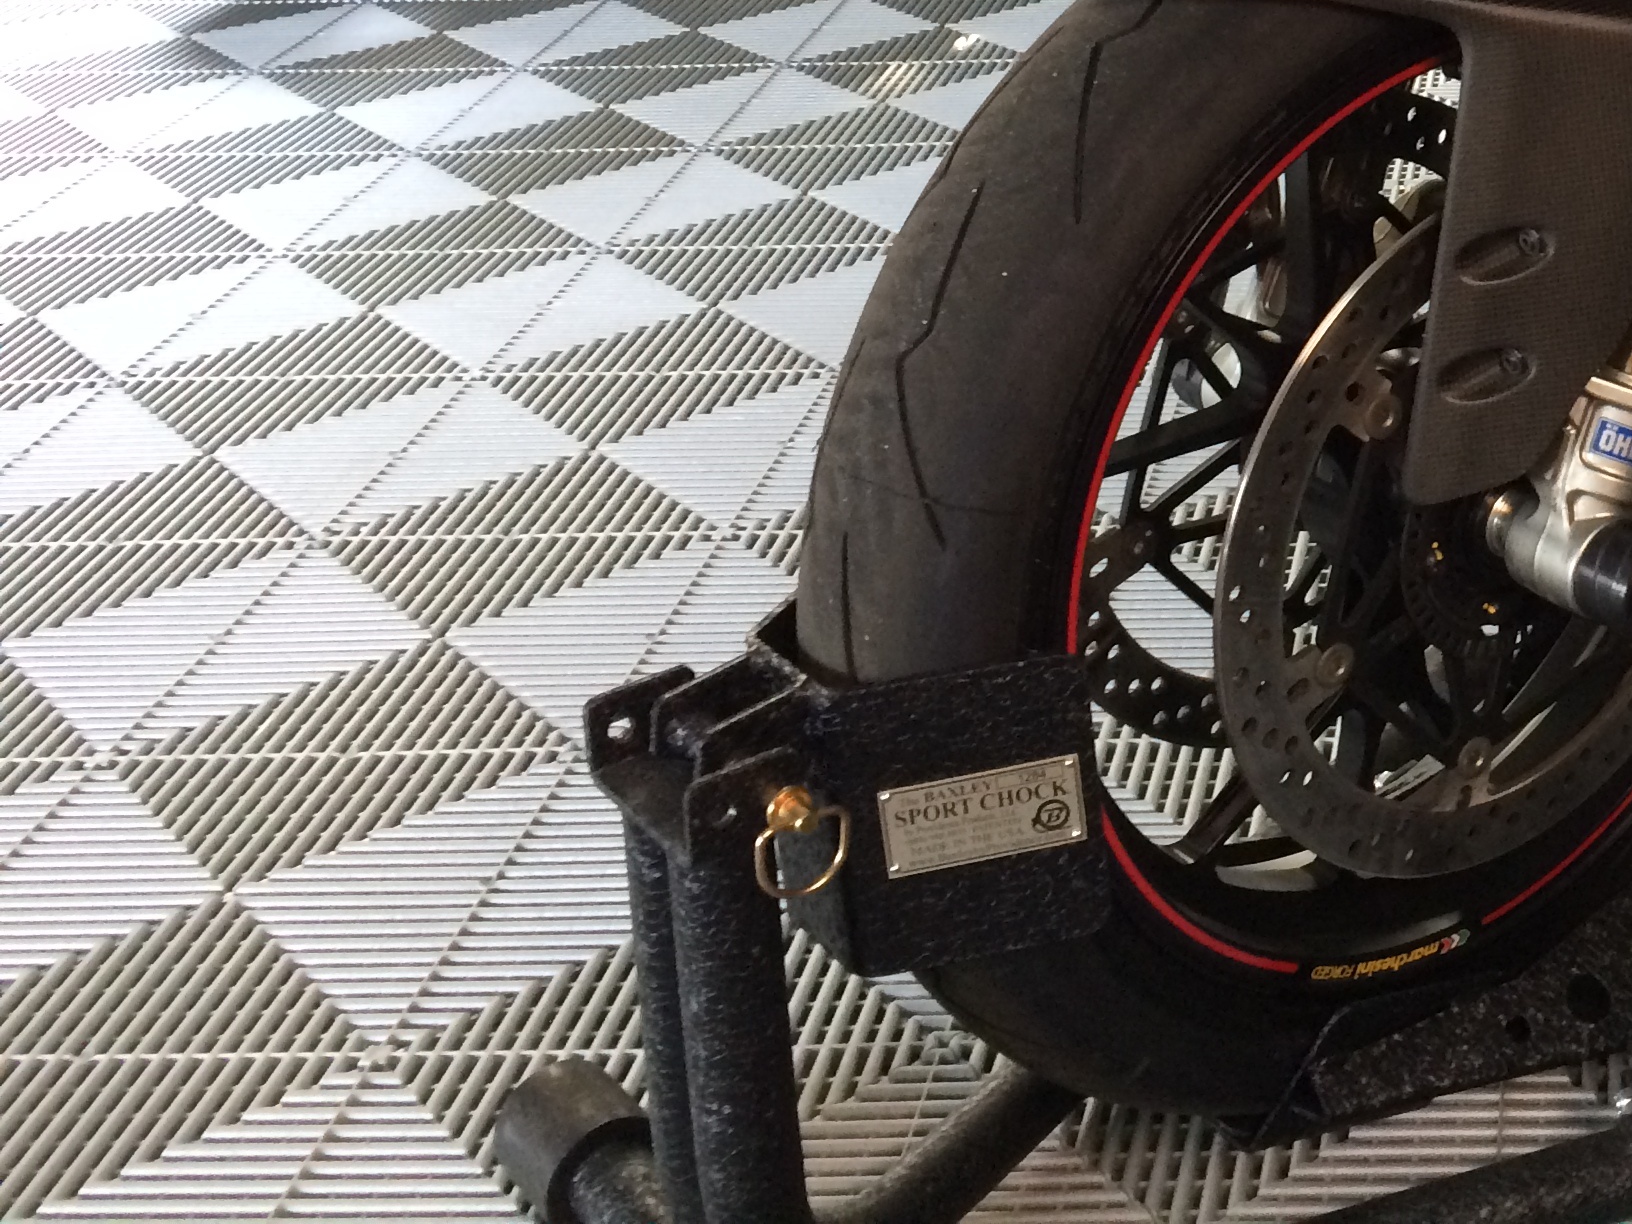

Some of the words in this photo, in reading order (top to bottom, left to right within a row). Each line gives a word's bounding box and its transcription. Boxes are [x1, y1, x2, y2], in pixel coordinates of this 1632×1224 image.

[895, 797, 974, 827] SPORT
[979, 779, 1070, 811] CHOCK
[924, 780, 992, 803] BAXLEY
